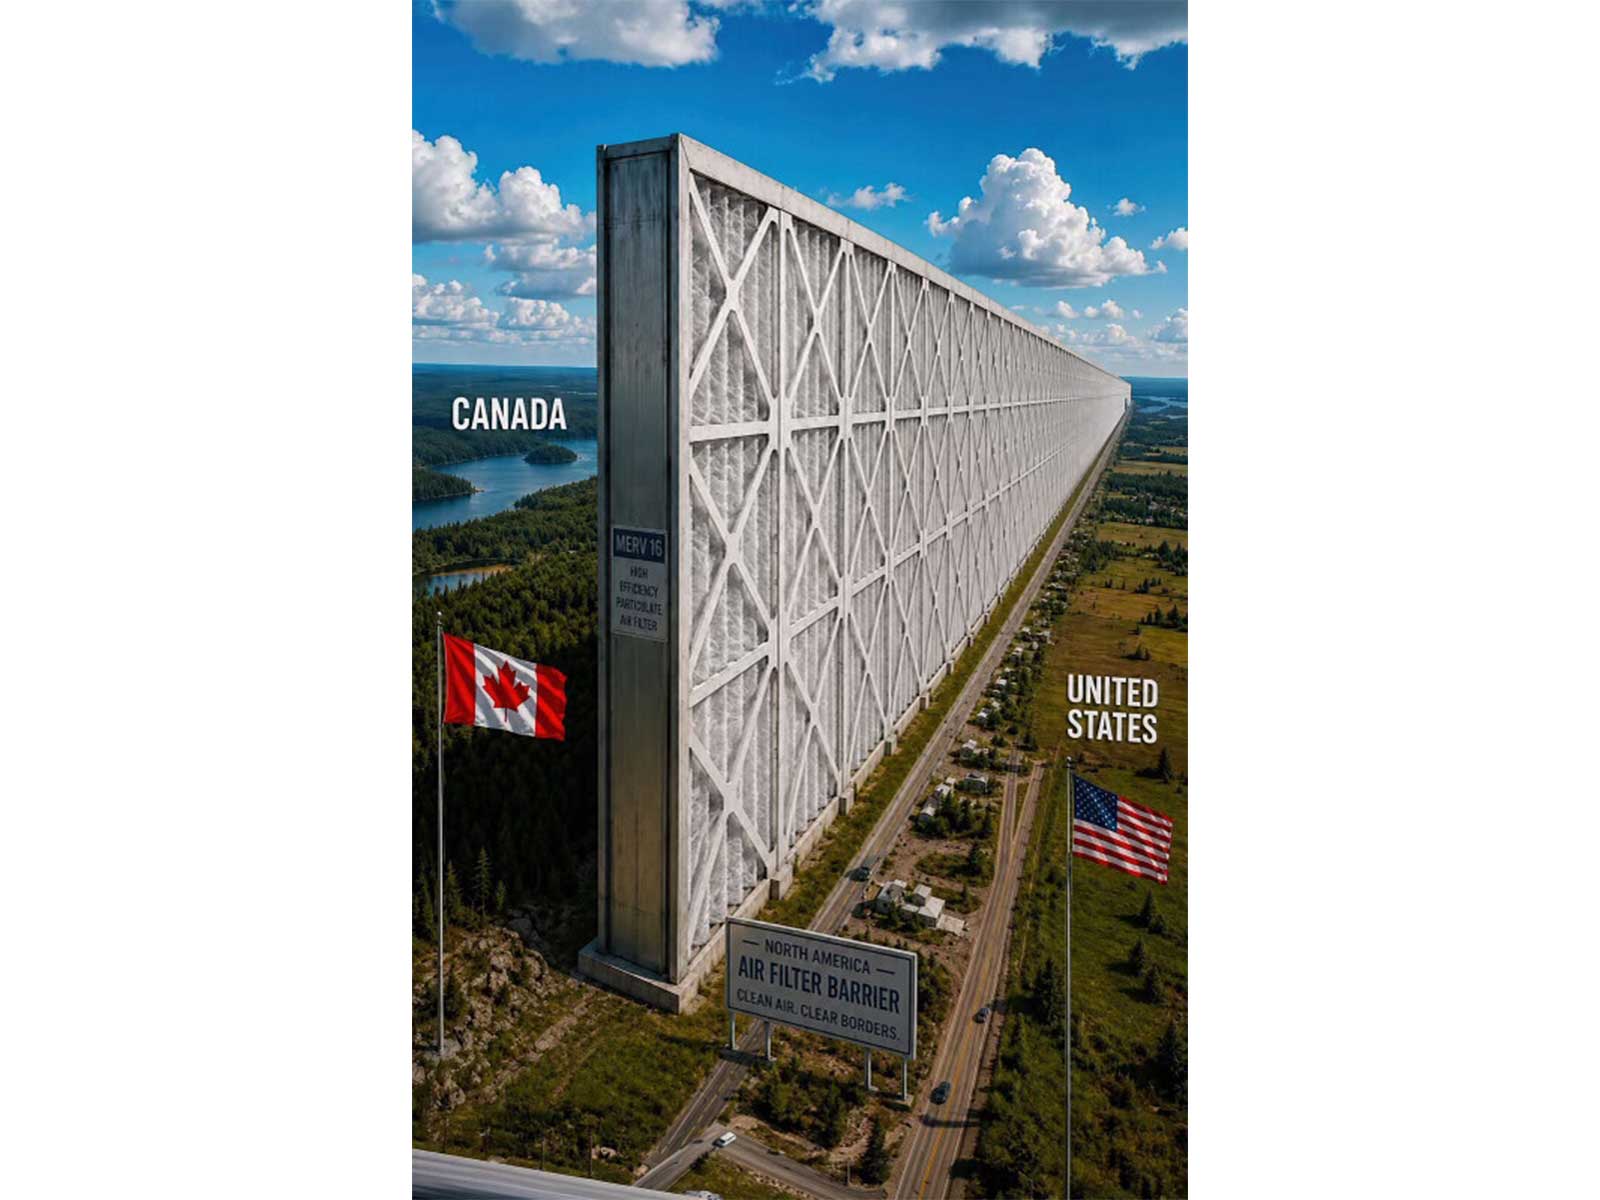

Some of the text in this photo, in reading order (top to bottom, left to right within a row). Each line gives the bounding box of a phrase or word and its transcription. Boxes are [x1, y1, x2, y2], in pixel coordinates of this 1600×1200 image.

[616, 534, 663, 557] MERV 16
[633, 616, 658, 632] FILTER
[765, 939, 871, 975] NORTH AMERICA
[738, 955, 900, 1014] AIR FILTER BARRIER
[736, 988, 900, 1041] CLEAN AIR. CLEAR BORDERS.
